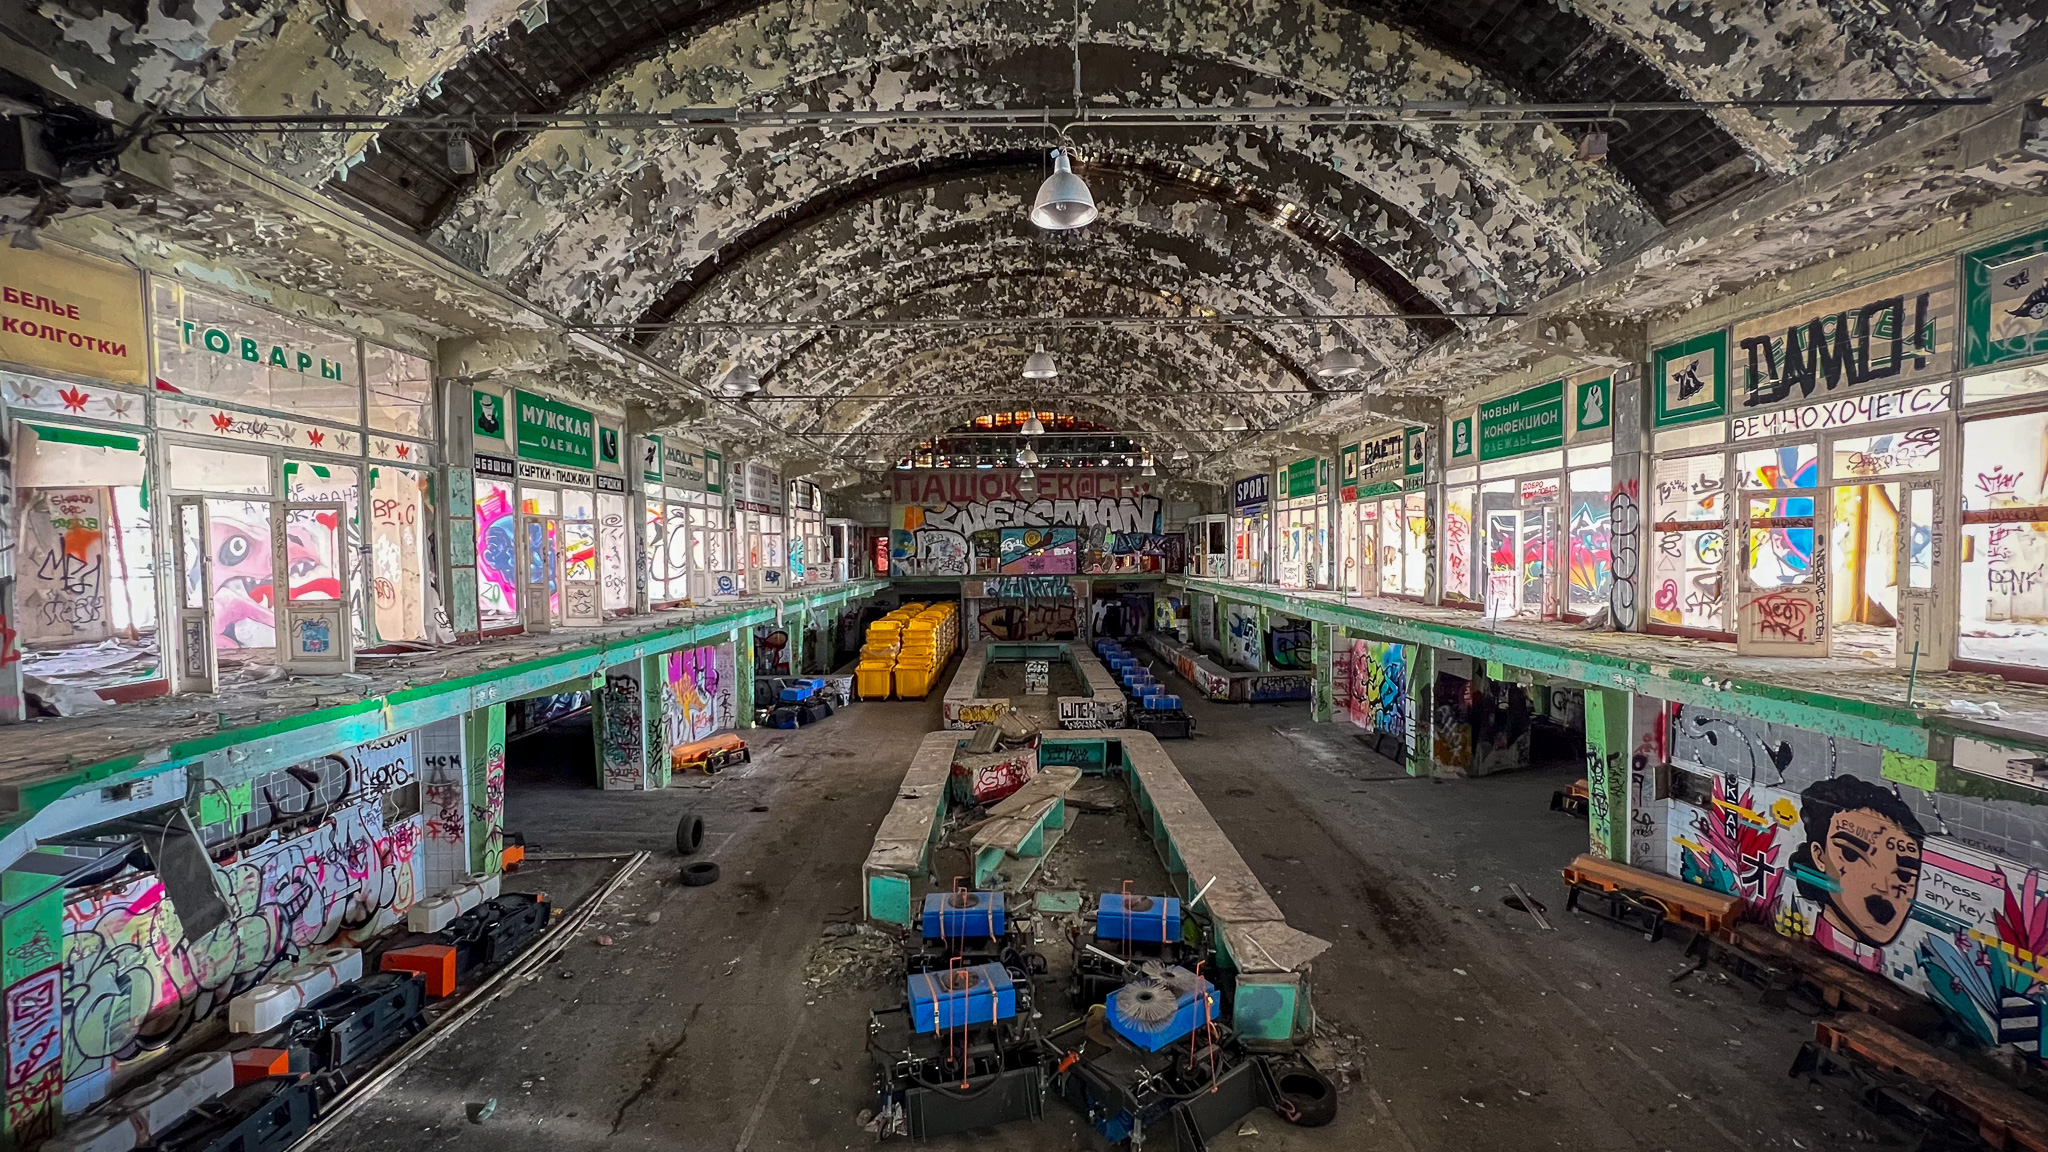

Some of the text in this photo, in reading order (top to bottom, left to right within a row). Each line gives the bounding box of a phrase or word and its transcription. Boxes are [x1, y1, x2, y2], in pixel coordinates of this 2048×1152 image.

[3, 286, 80, 320] БЕЛЬЕ
[2, 316, 127, 357] КОЛГОТКИ
[174, 317, 342, 382] ТОВАРЫ
[522, 403, 591, 438] МУЖСКАЯ
[1481, 399, 1520, 420] НОВЫЙ
[1484, 409, 1558, 438] КОНФЕКЦИОН
[541, 435, 588, 456] ОДЕЖДА
[1484, 433, 1531, 453] ОДЕЖДЫ
[519, 463, 591, 486] КУРТКИ ПИДЖАКИ
[598, 476, 622, 491] БРЮКИ
[1237, 476, 1268, 502] SPORT
[1886, 836, 1917, 853] 666
[1925, 888, 1955, 911] any
